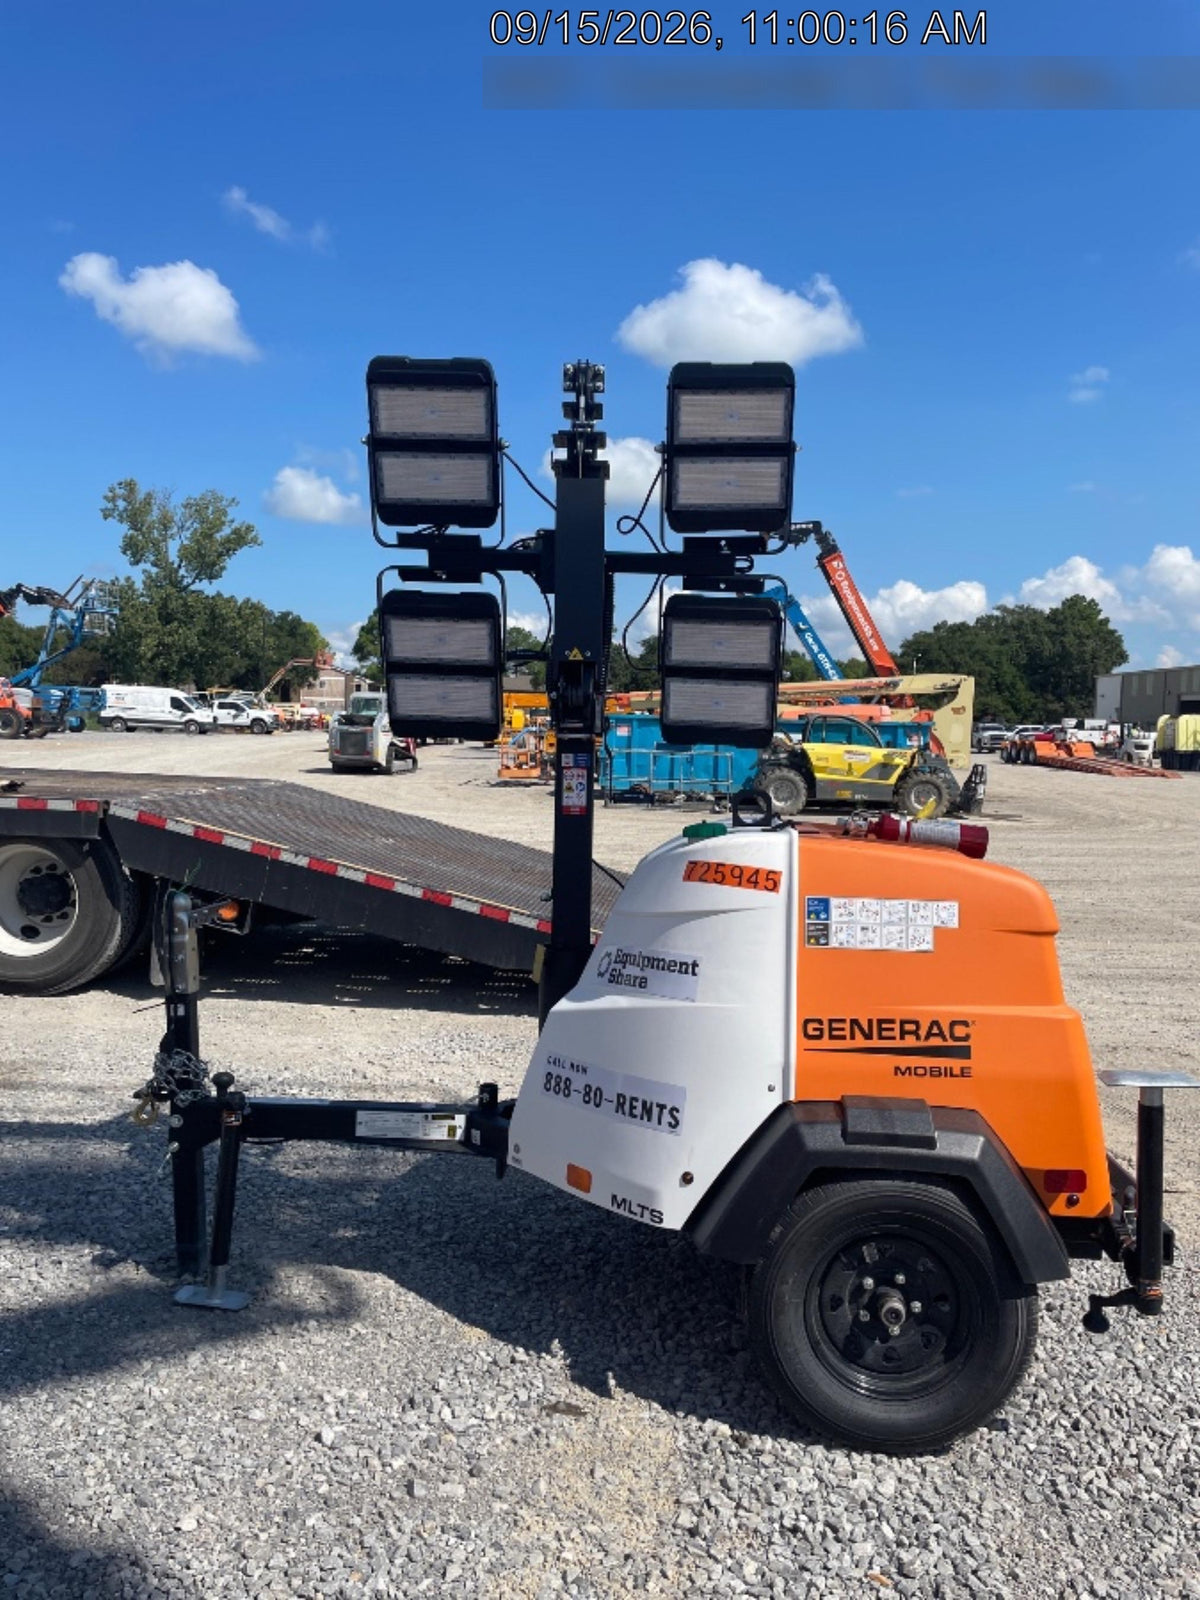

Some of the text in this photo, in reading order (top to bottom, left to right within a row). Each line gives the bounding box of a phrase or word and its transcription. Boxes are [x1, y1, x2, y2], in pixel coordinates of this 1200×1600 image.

[686, 861, 778, 892] 725945
[613, 948, 699, 977] Equipment
[608, 968, 648, 989] Share
[802, 1018, 972, 1042] GENERAC
[894, 1066, 973, 1078] MOBILE
[543, 1071, 681, 1130] 888-80-RENTS
[611, 1194, 664, 1225] MLTS
